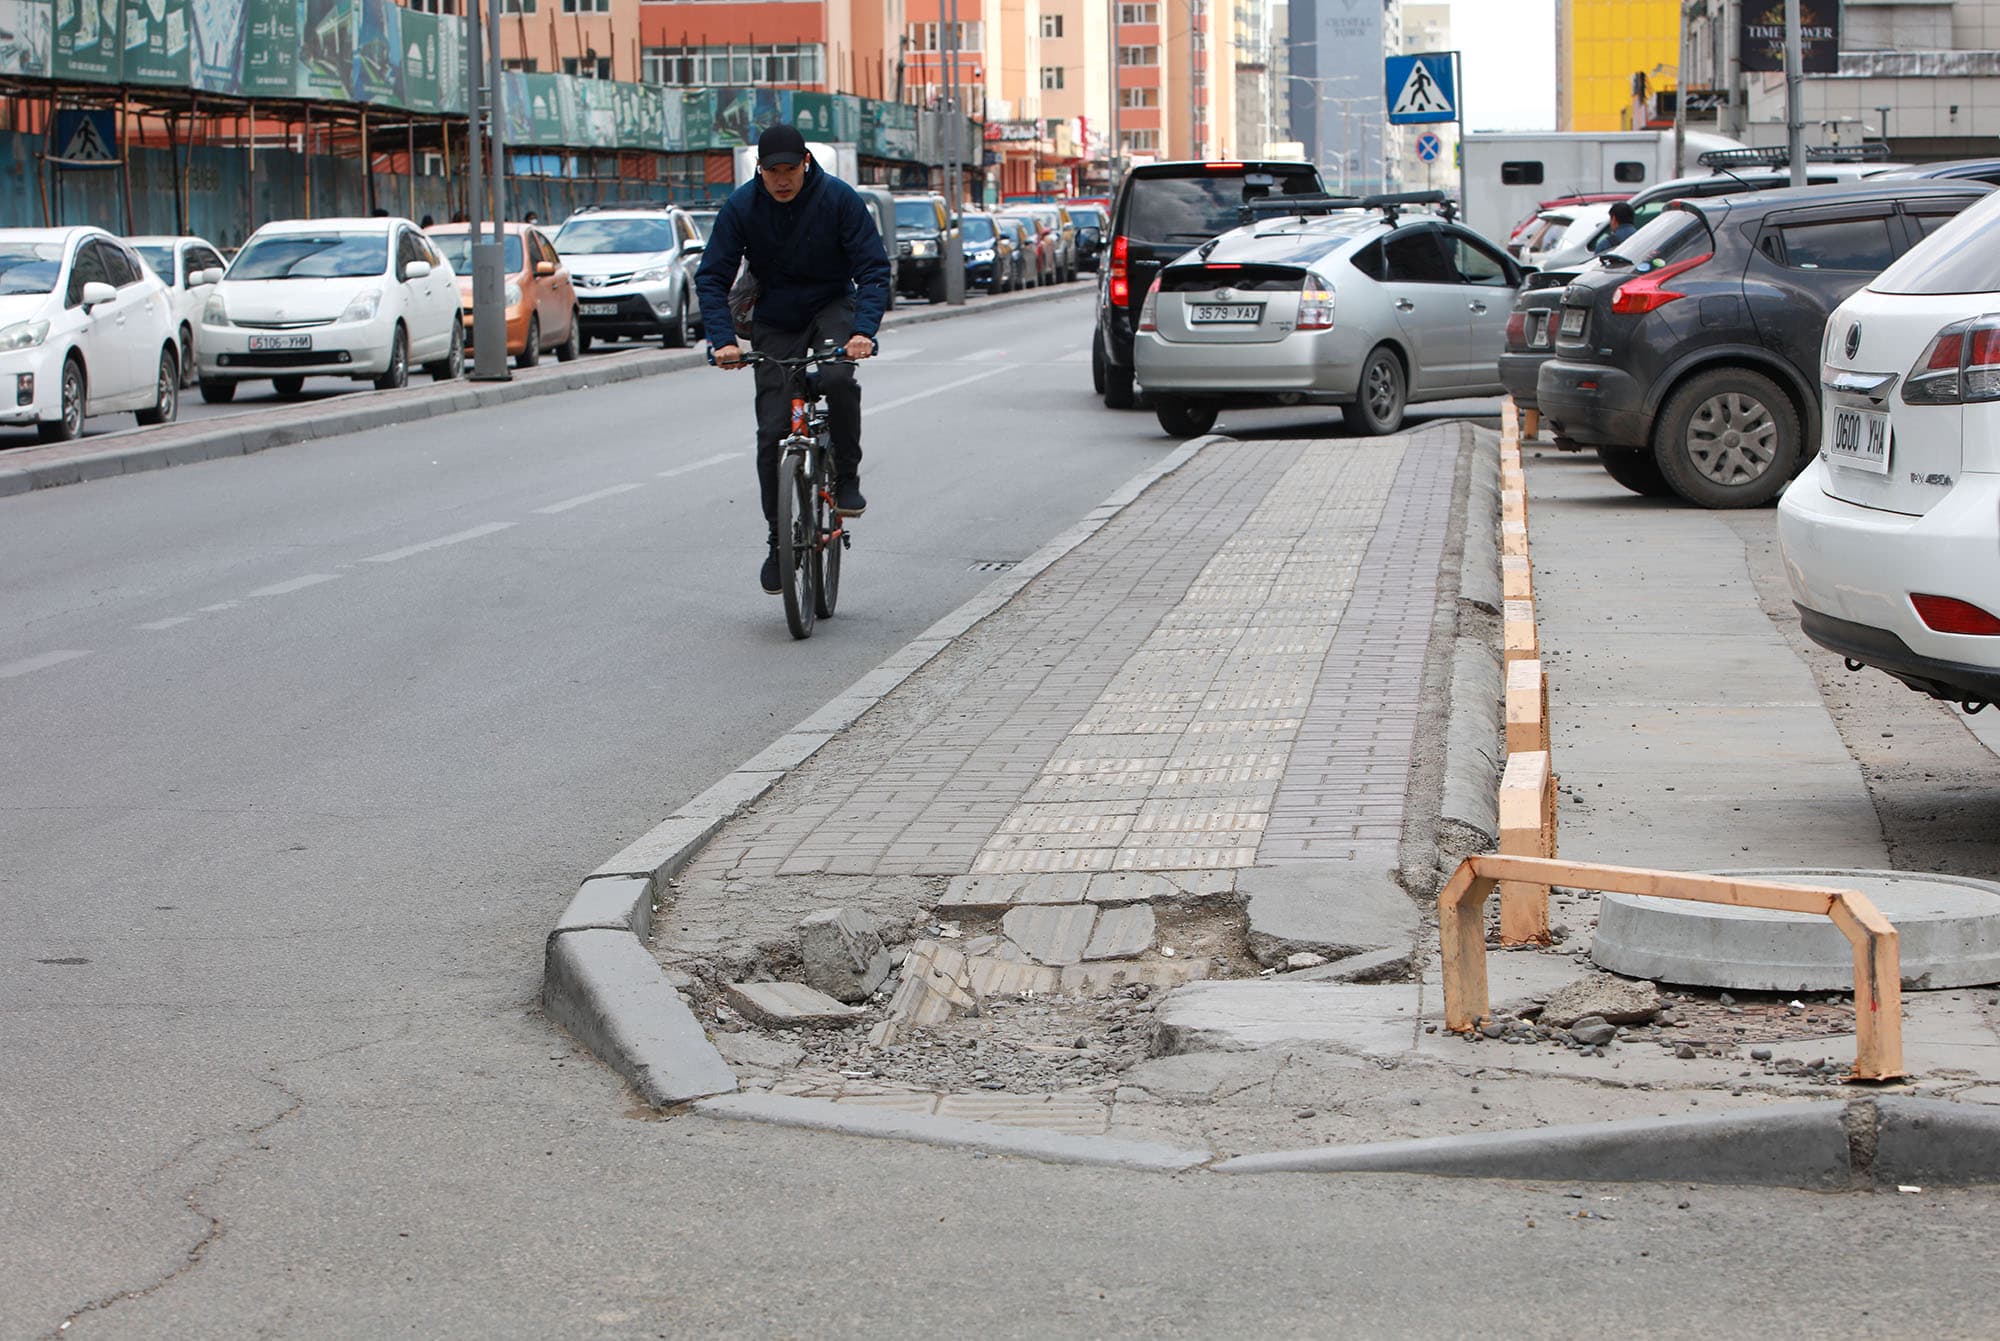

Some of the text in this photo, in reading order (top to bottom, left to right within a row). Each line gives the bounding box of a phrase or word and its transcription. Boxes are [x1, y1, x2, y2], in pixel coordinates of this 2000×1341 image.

[1748, 26, 1780, 38] TIME
[1198, 307, 1229, 320] 3579
[1835, 413, 1861, 452] 0600
